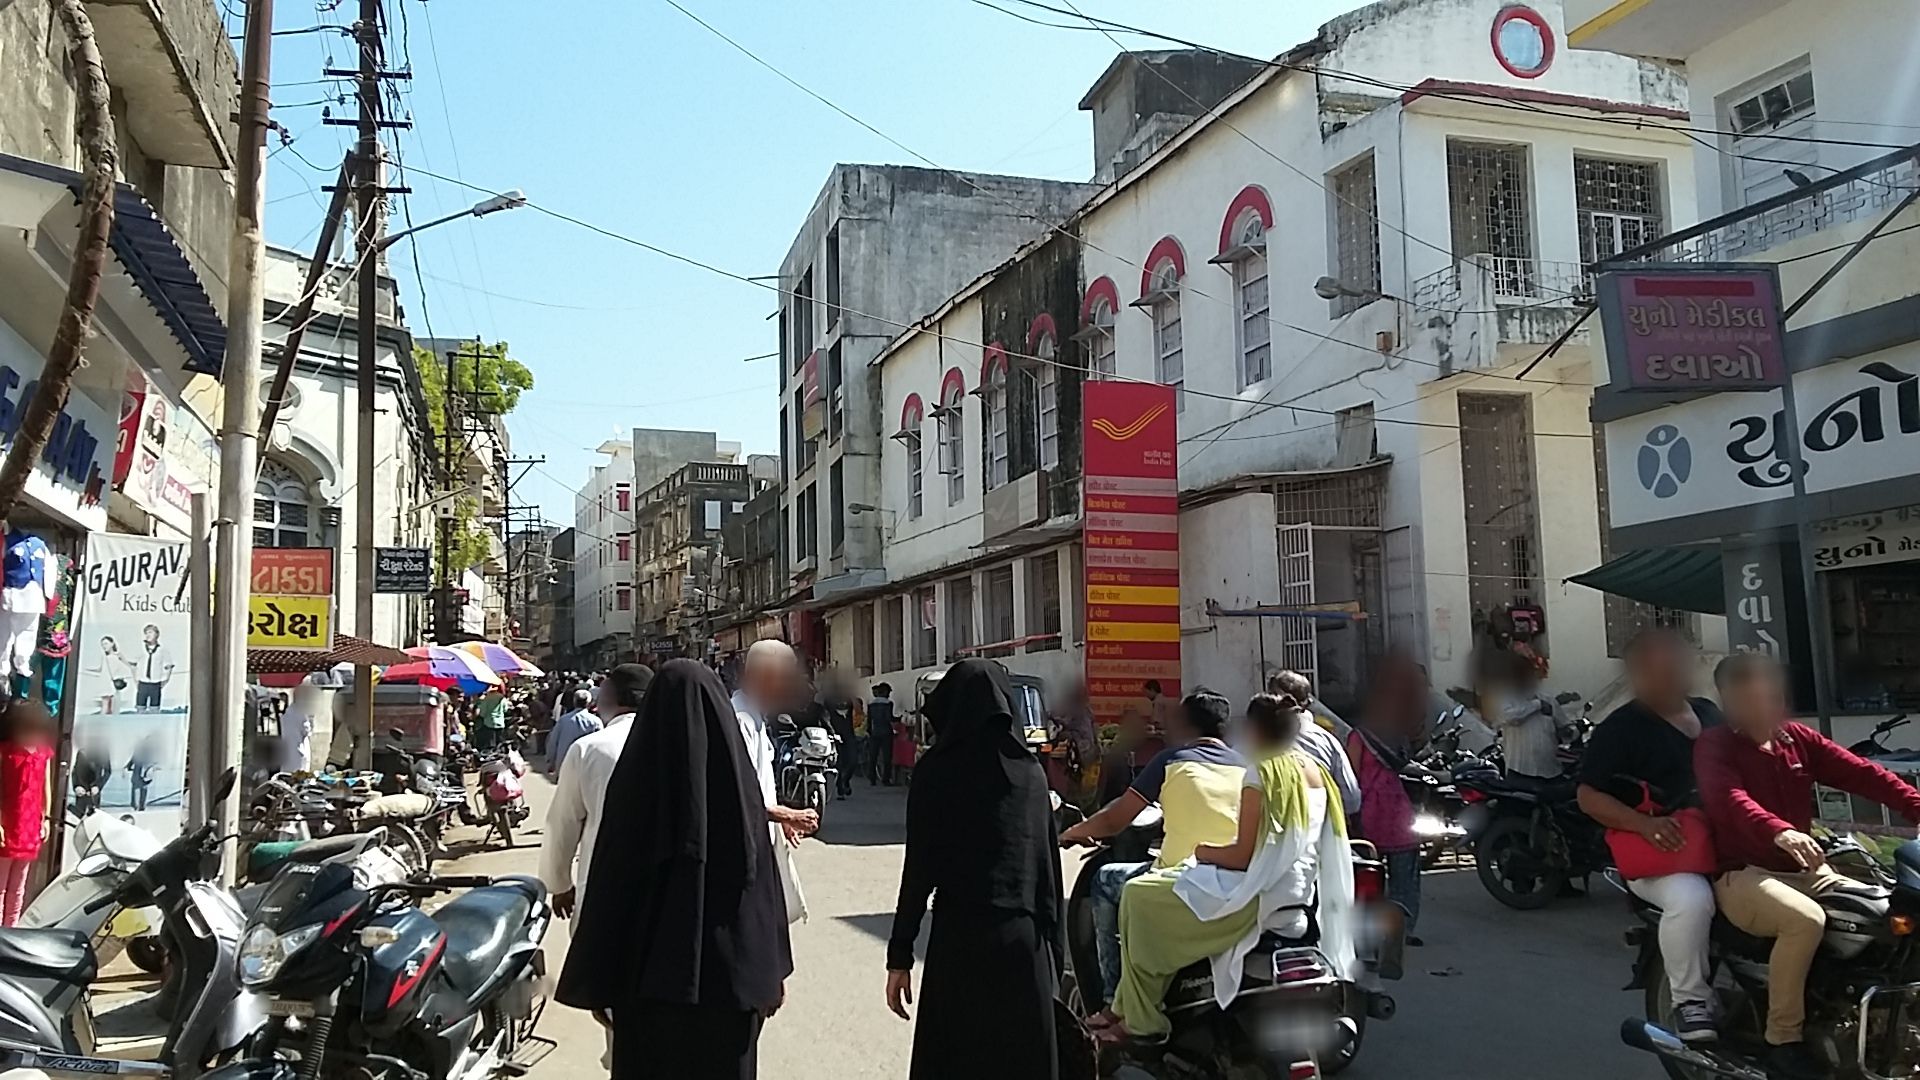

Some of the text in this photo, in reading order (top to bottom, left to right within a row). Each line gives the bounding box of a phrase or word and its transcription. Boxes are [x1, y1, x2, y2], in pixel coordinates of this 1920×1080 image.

[1628, 297, 1767, 336] યુનો મેડીકલ
[1646, 343, 1765, 381] દવાઓ
[1726, 362, 1920, 488] યુનો
[1814, 536, 1886, 567] યુનો
[88, 543, 184, 601] GAURAV
[252, 566, 324, 594] ટાકડા
[122, 593, 158, 612] Kids
[47, 1057, 109, 1073] Activa
